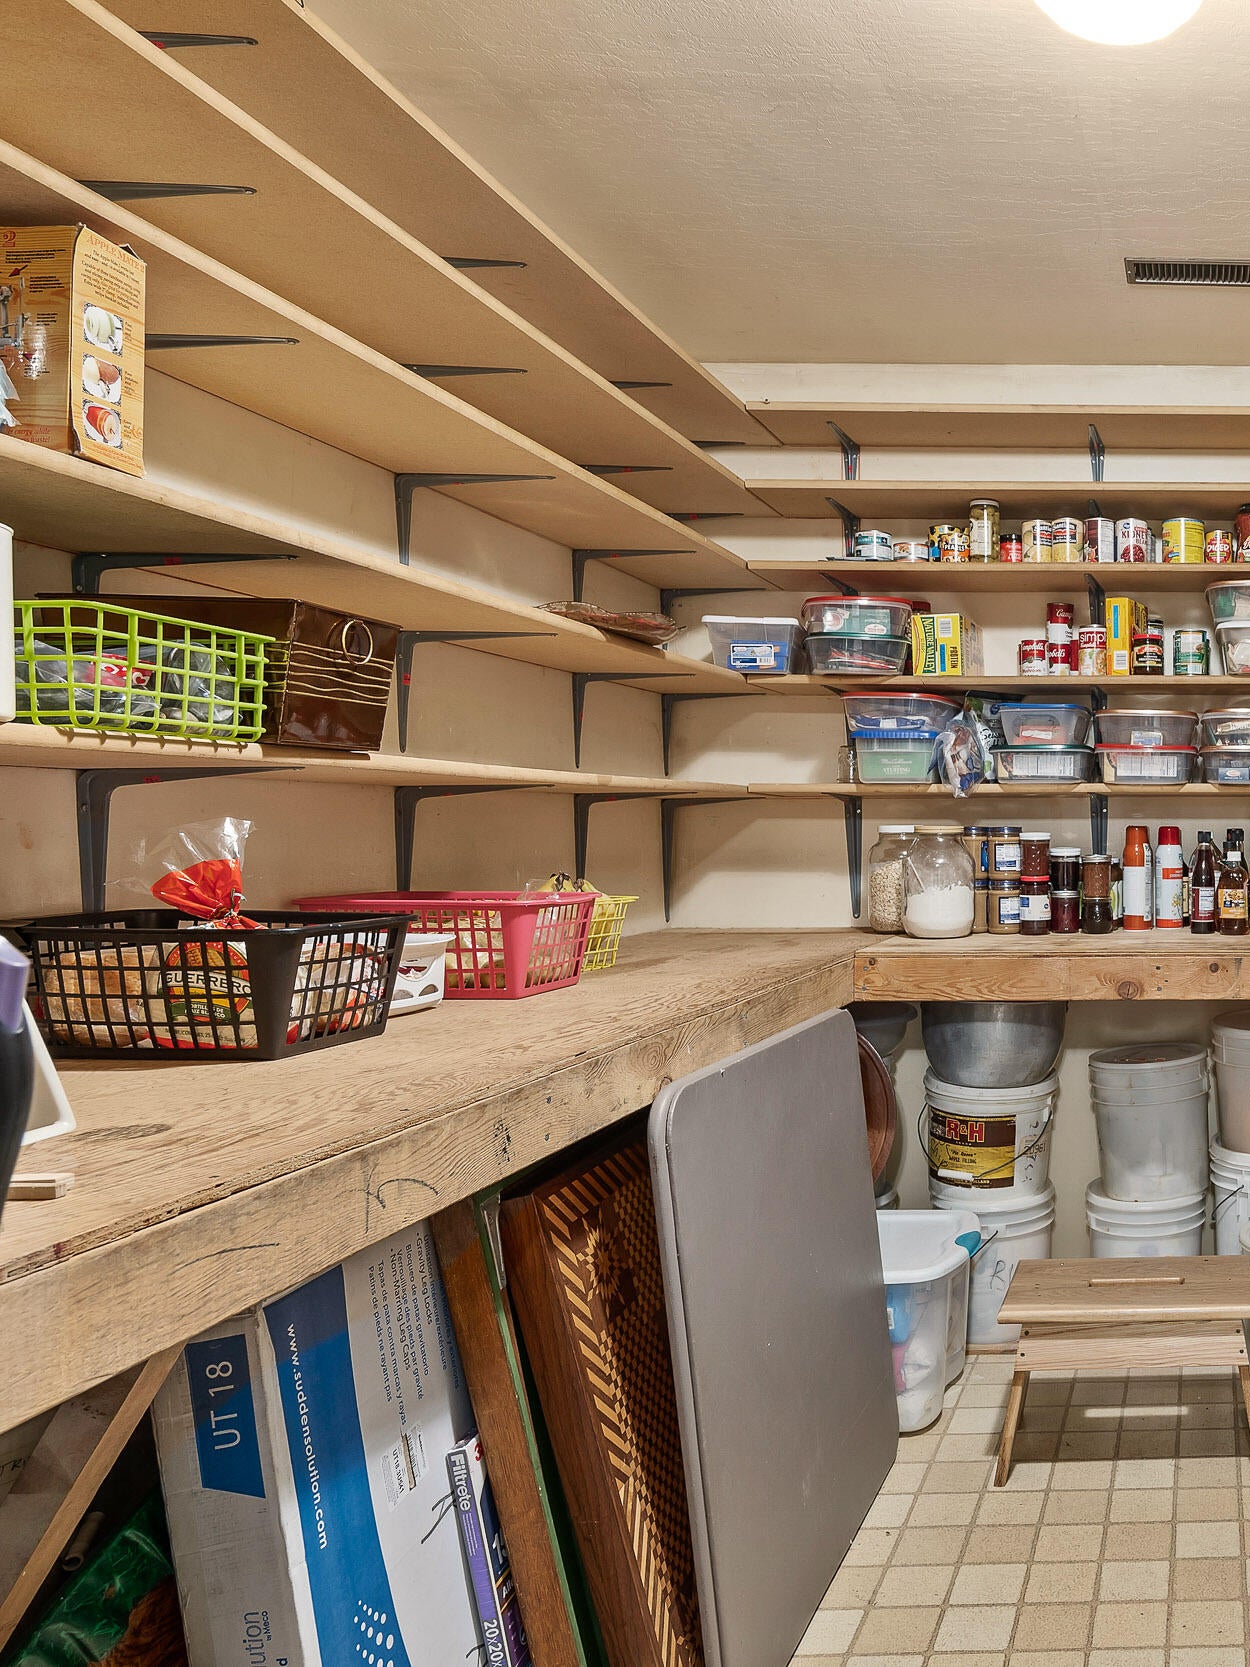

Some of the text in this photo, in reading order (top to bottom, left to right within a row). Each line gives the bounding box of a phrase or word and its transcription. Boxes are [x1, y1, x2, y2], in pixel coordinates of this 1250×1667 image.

[923, 619, 934, 646] NATURE
[1080, 633, 1106, 645] simpl
[950, 646, 958, 668] PROTEIN
[166, 971, 252, 994] GUERRERO
[945, 1118, 985, 1143] R&H
[378, 1260, 386, 1288] Tapas
[416, 1238, 432, 1325] Gravity Leg Locks
[381, 1289, 388, 1302] de
[390, 1254, 402, 1321] Non-Marring
[399, 1322, 407, 1342] Leg
[405, 1244, 428, 1376] Bloqueo de patas gravitatorio
[368, 1266, 392, 1402] Patins de pieds ne rayant pas
[386, 1326, 395, 1357] contra
[407, 1324, 415, 1348] pieds
[409, 1351, 417, 1367] par
[391, 1358, 401, 1392] marcas
[412, 1368, 423, 1400] gravité
[205, 1359, 241, 1451] UT 18
[398, 1400, 407, 1426] rayas
[287, 1323, 327, 1551] www.suddensolution.com
[450, 1453, 472, 1512] Filtrete
[261, 1611, 271, 1634] Meco
[243, 1611, 266, 1667] ution
